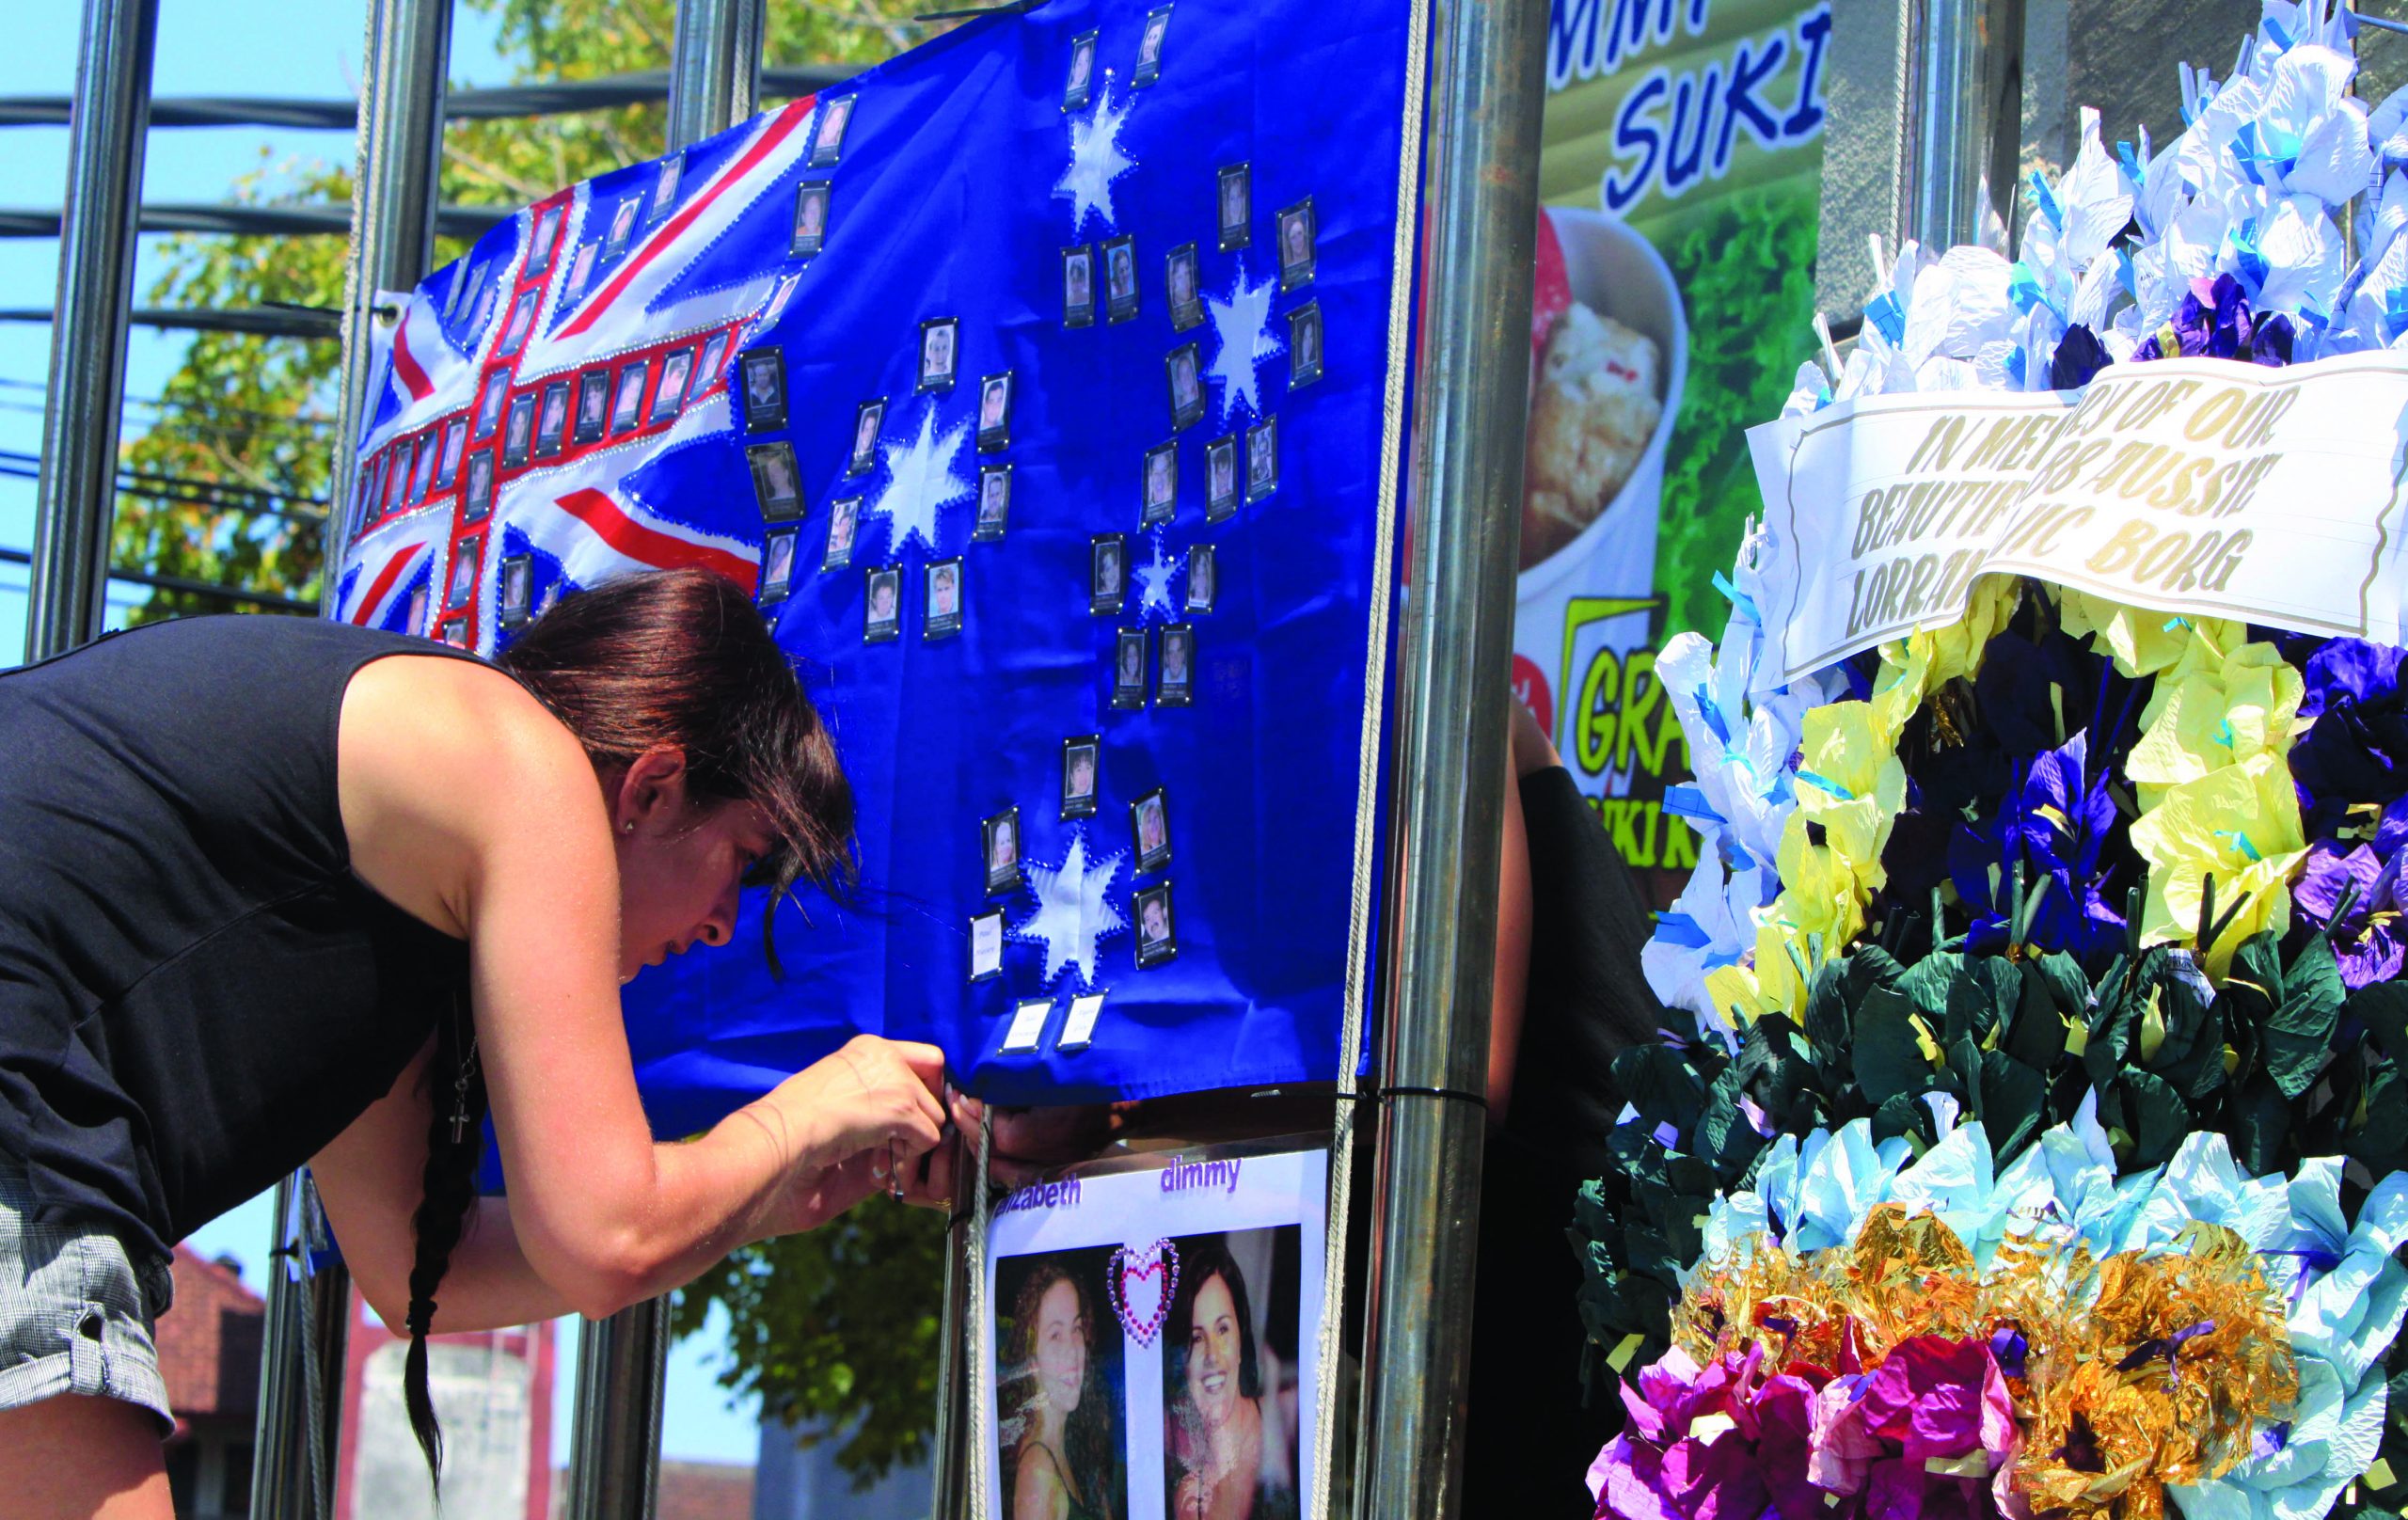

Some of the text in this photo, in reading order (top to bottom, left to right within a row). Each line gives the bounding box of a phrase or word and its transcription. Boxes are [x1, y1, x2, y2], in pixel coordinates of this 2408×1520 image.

[1605, 9, 1832, 212] SUKI
[1905, 414, 1986, 474] IN
[2113, 378, 2204, 433] OF
[2182, 385, 2302, 451] OUR
[2084, 517, 2254, 593] BORG
[1576, 648, 1695, 777] GRA
[1160, 1154, 1243, 1194] dimmy
